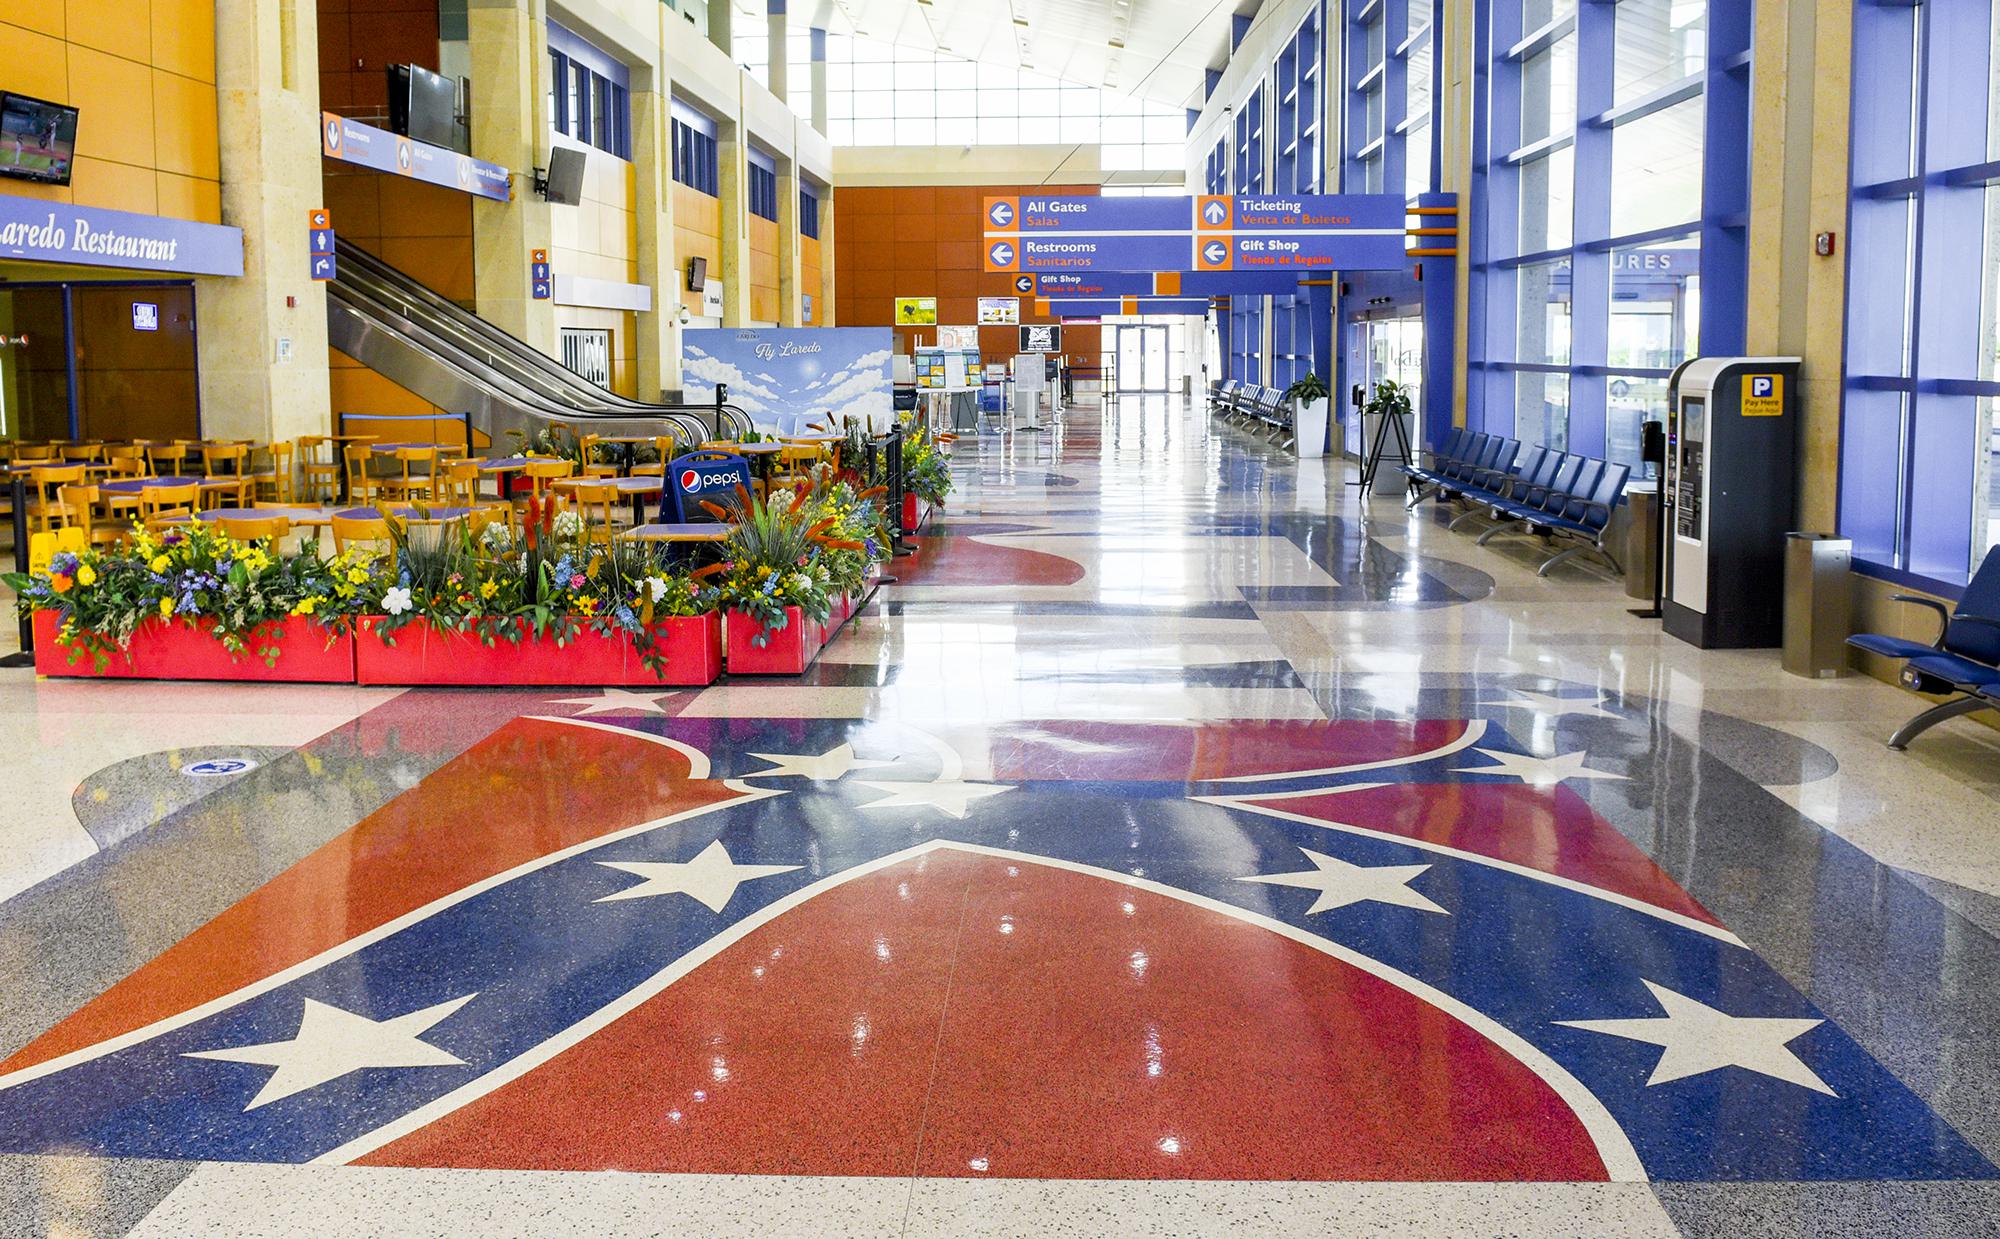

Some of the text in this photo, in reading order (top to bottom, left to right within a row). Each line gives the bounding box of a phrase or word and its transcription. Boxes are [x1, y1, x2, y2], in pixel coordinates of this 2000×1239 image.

[1027, 202, 1088, 213] All Gates
[1240, 200, 1302, 214] Ticketing
[1026, 215, 1060, 227] Salas
[1241, 214, 1351, 225] Venta de Boletos
[0, 213, 178, 261] aredo Restaurant
[1026, 242, 1097, 253] Restrooms
[1240, 240, 1300, 253] Gift Shop
[1027, 257, 1092, 267] Sanitarios
[1242, 255, 1333, 267] Tienda de Regalos
[1041, 275, 1082, 285] Gift Shop
[755, 341, 822, 361] Fly Laredo
[1754, 378, 1770, 396] P
[1744, 399, 1759, 408] Pay
[703, 470, 741, 488] pepsi
